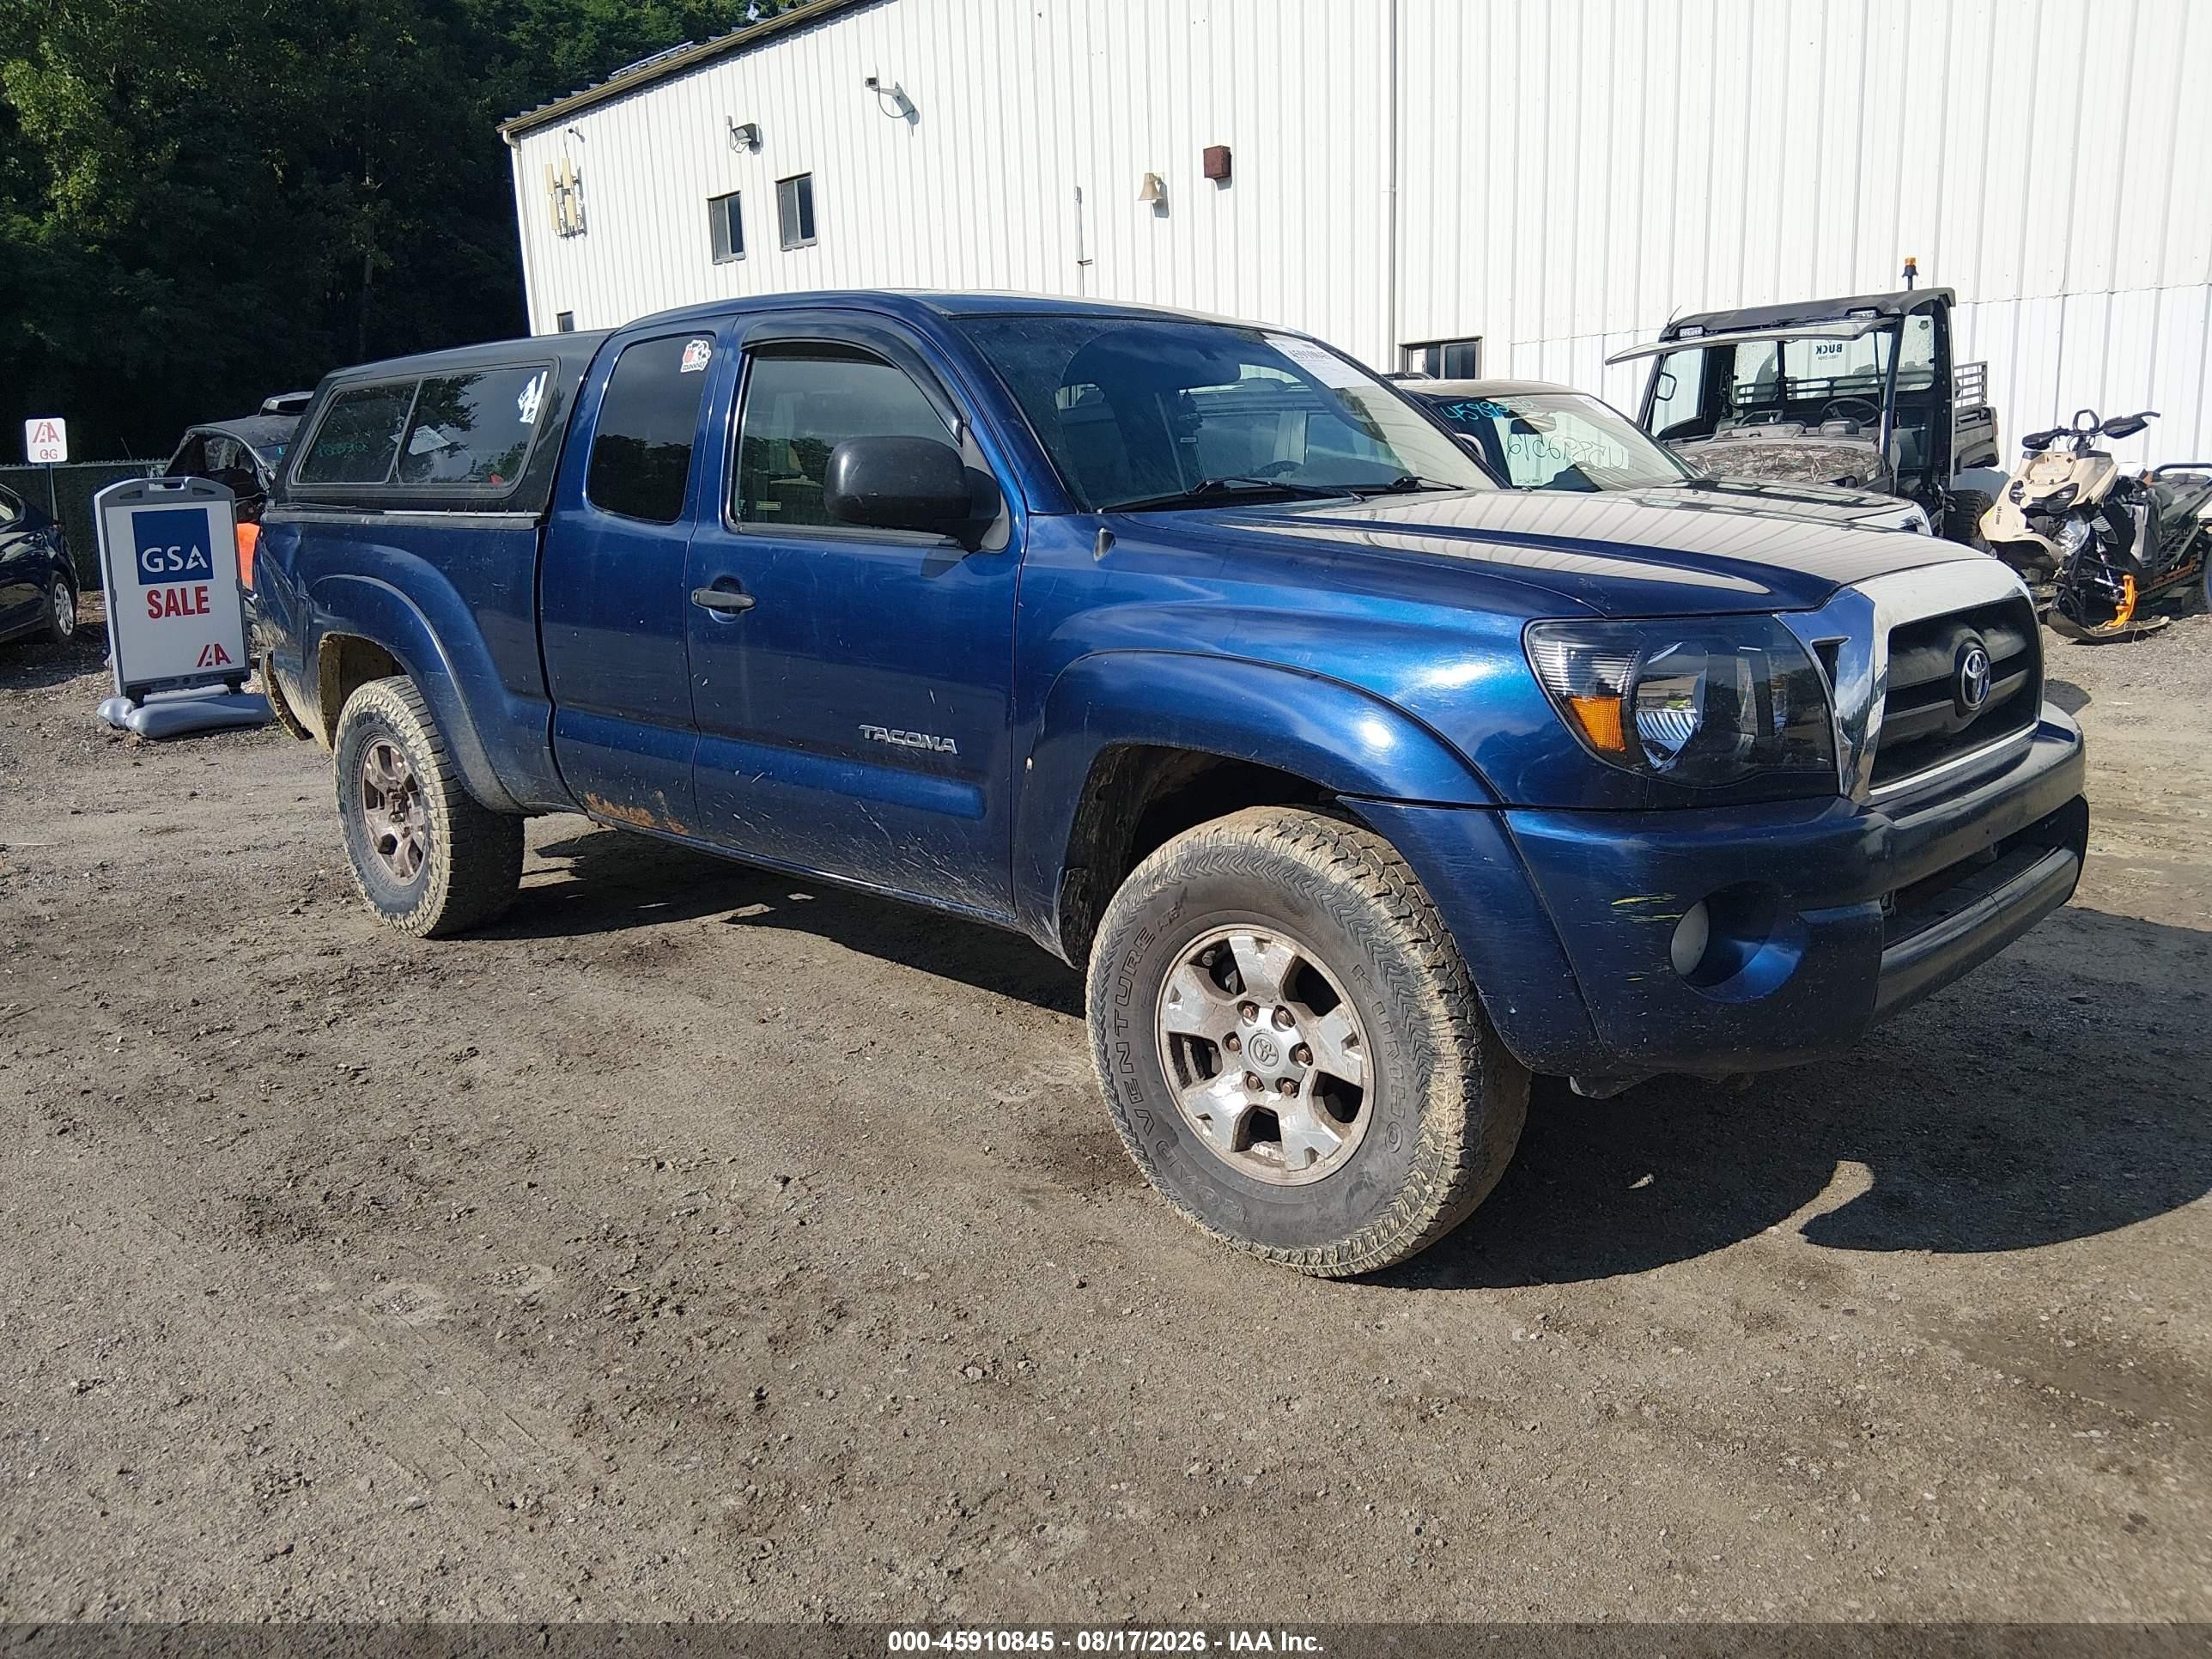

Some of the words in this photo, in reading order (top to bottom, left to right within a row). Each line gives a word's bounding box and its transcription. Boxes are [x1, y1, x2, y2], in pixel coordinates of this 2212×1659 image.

[141, 543, 209, 573] GSA
[146, 586, 211, 619] SALE
[197, 643, 234, 668] IAA
[859, 724, 958, 755] TACOMA
[1113, 926, 1156, 1136] VENTURE
[1351, 963, 1407, 1154] KUMHO
